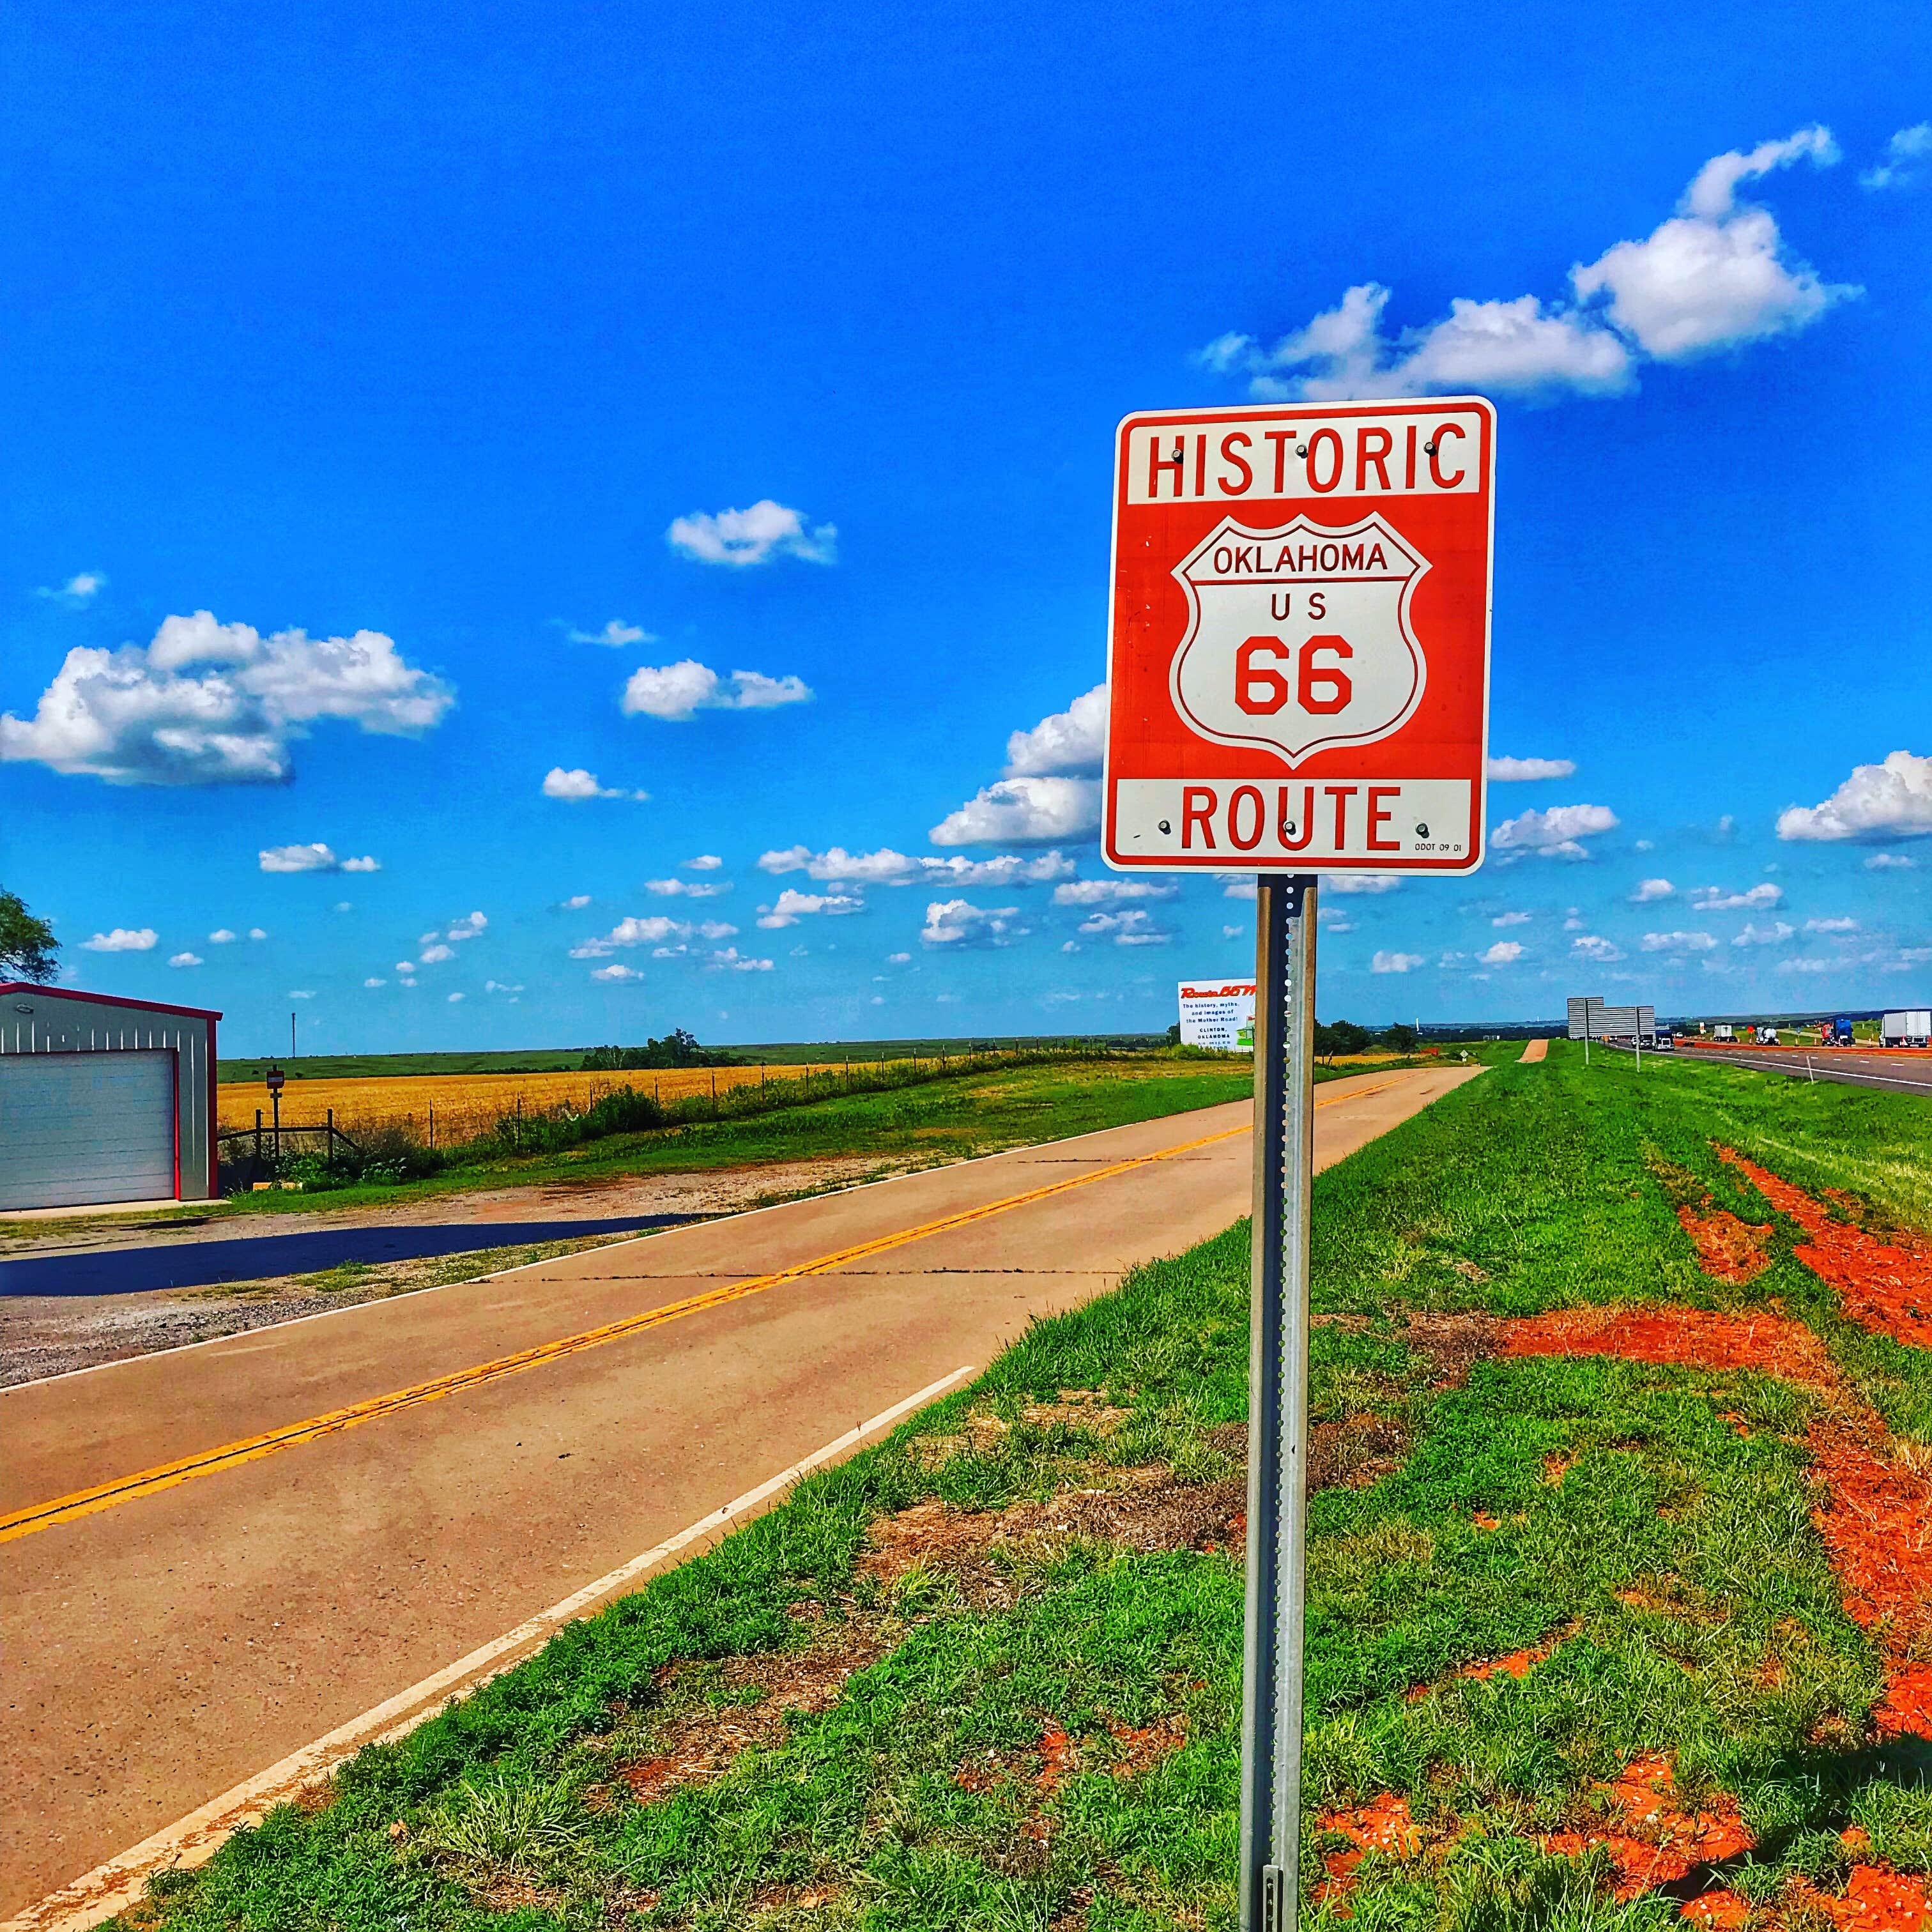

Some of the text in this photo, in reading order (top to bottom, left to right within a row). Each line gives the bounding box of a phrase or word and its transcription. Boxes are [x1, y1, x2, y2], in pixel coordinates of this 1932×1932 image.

[1148, 422, 1466, 498] HISTORIC
[1213, 542, 1388, 574] OKLAHOMA
[1234, 634, 1353, 716] 66
[1181, 785, 1401, 852] ROUTE
[1414, 843, 1436, 851] ODOT
[1439, 843, 1450, 852] 09
[1181, 987, 1219, 999] Route
[1219, 986, 1241, 997] 66
